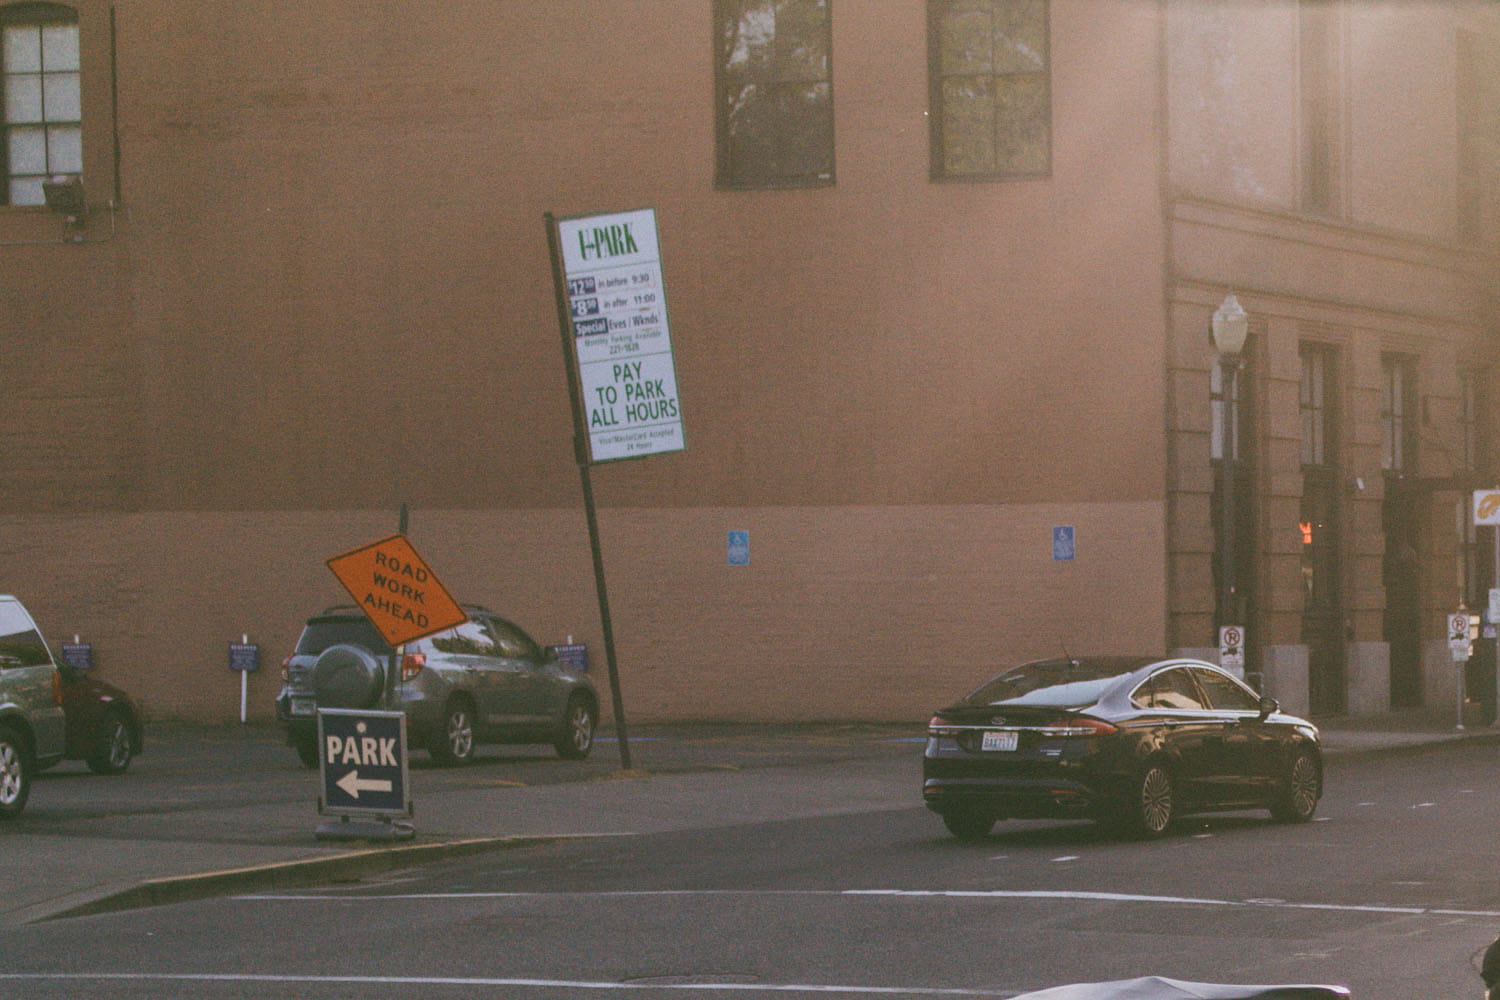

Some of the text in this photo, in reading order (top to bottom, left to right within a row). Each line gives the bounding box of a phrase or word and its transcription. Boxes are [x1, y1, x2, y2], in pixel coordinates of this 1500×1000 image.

[607, 276, 628, 287] before
[632, 273, 649, 283] 9:30
[612, 296, 628, 307] after
[633, 294, 655, 304] 11:00
[576, 320, 606, 337] Special
[609, 319, 626, 330] Eves
[632, 314, 658, 326] Wknds
[613, 361, 642, 383] PAY
[595, 379, 666, 406] TO PARK
[591, 399, 678, 428] ALL HOURS
[375, 551, 428, 583] ROAD
[373, 572, 425, 604] WORK
[364, 592, 429, 628] AHEAD
[327, 735, 399, 767] PARK
